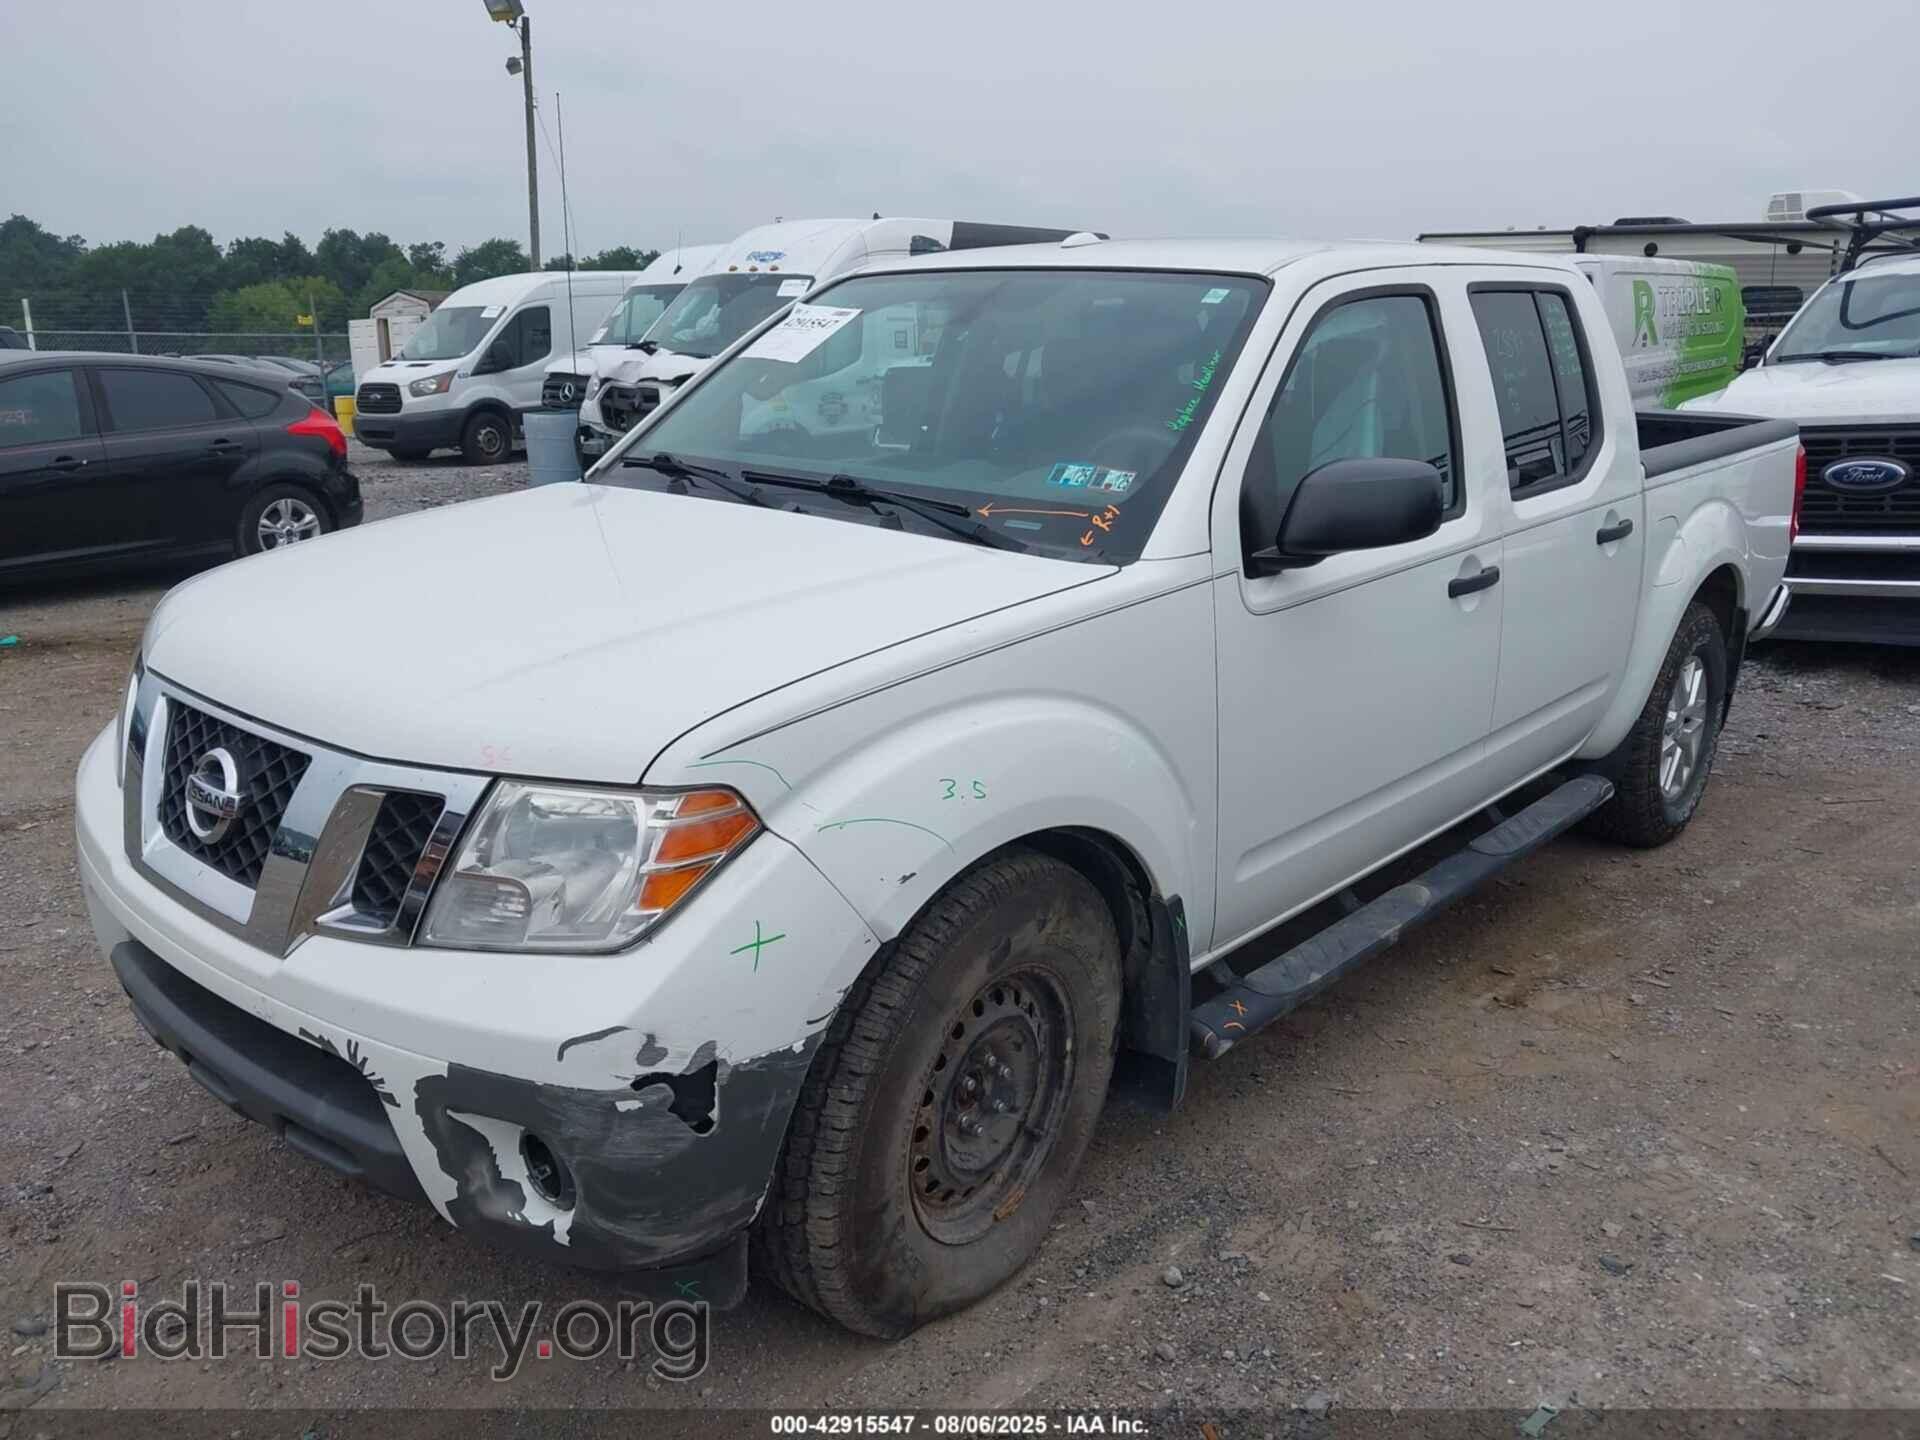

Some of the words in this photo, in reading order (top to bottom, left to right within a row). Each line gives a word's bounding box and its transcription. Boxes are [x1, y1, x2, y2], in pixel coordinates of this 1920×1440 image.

[1658, 285, 1711, 317] TRIPLE
[1712, 286, 1723, 313] R
[1843, 466, 1887, 481] Ford
[939, 778, 987, 800] 3.5
